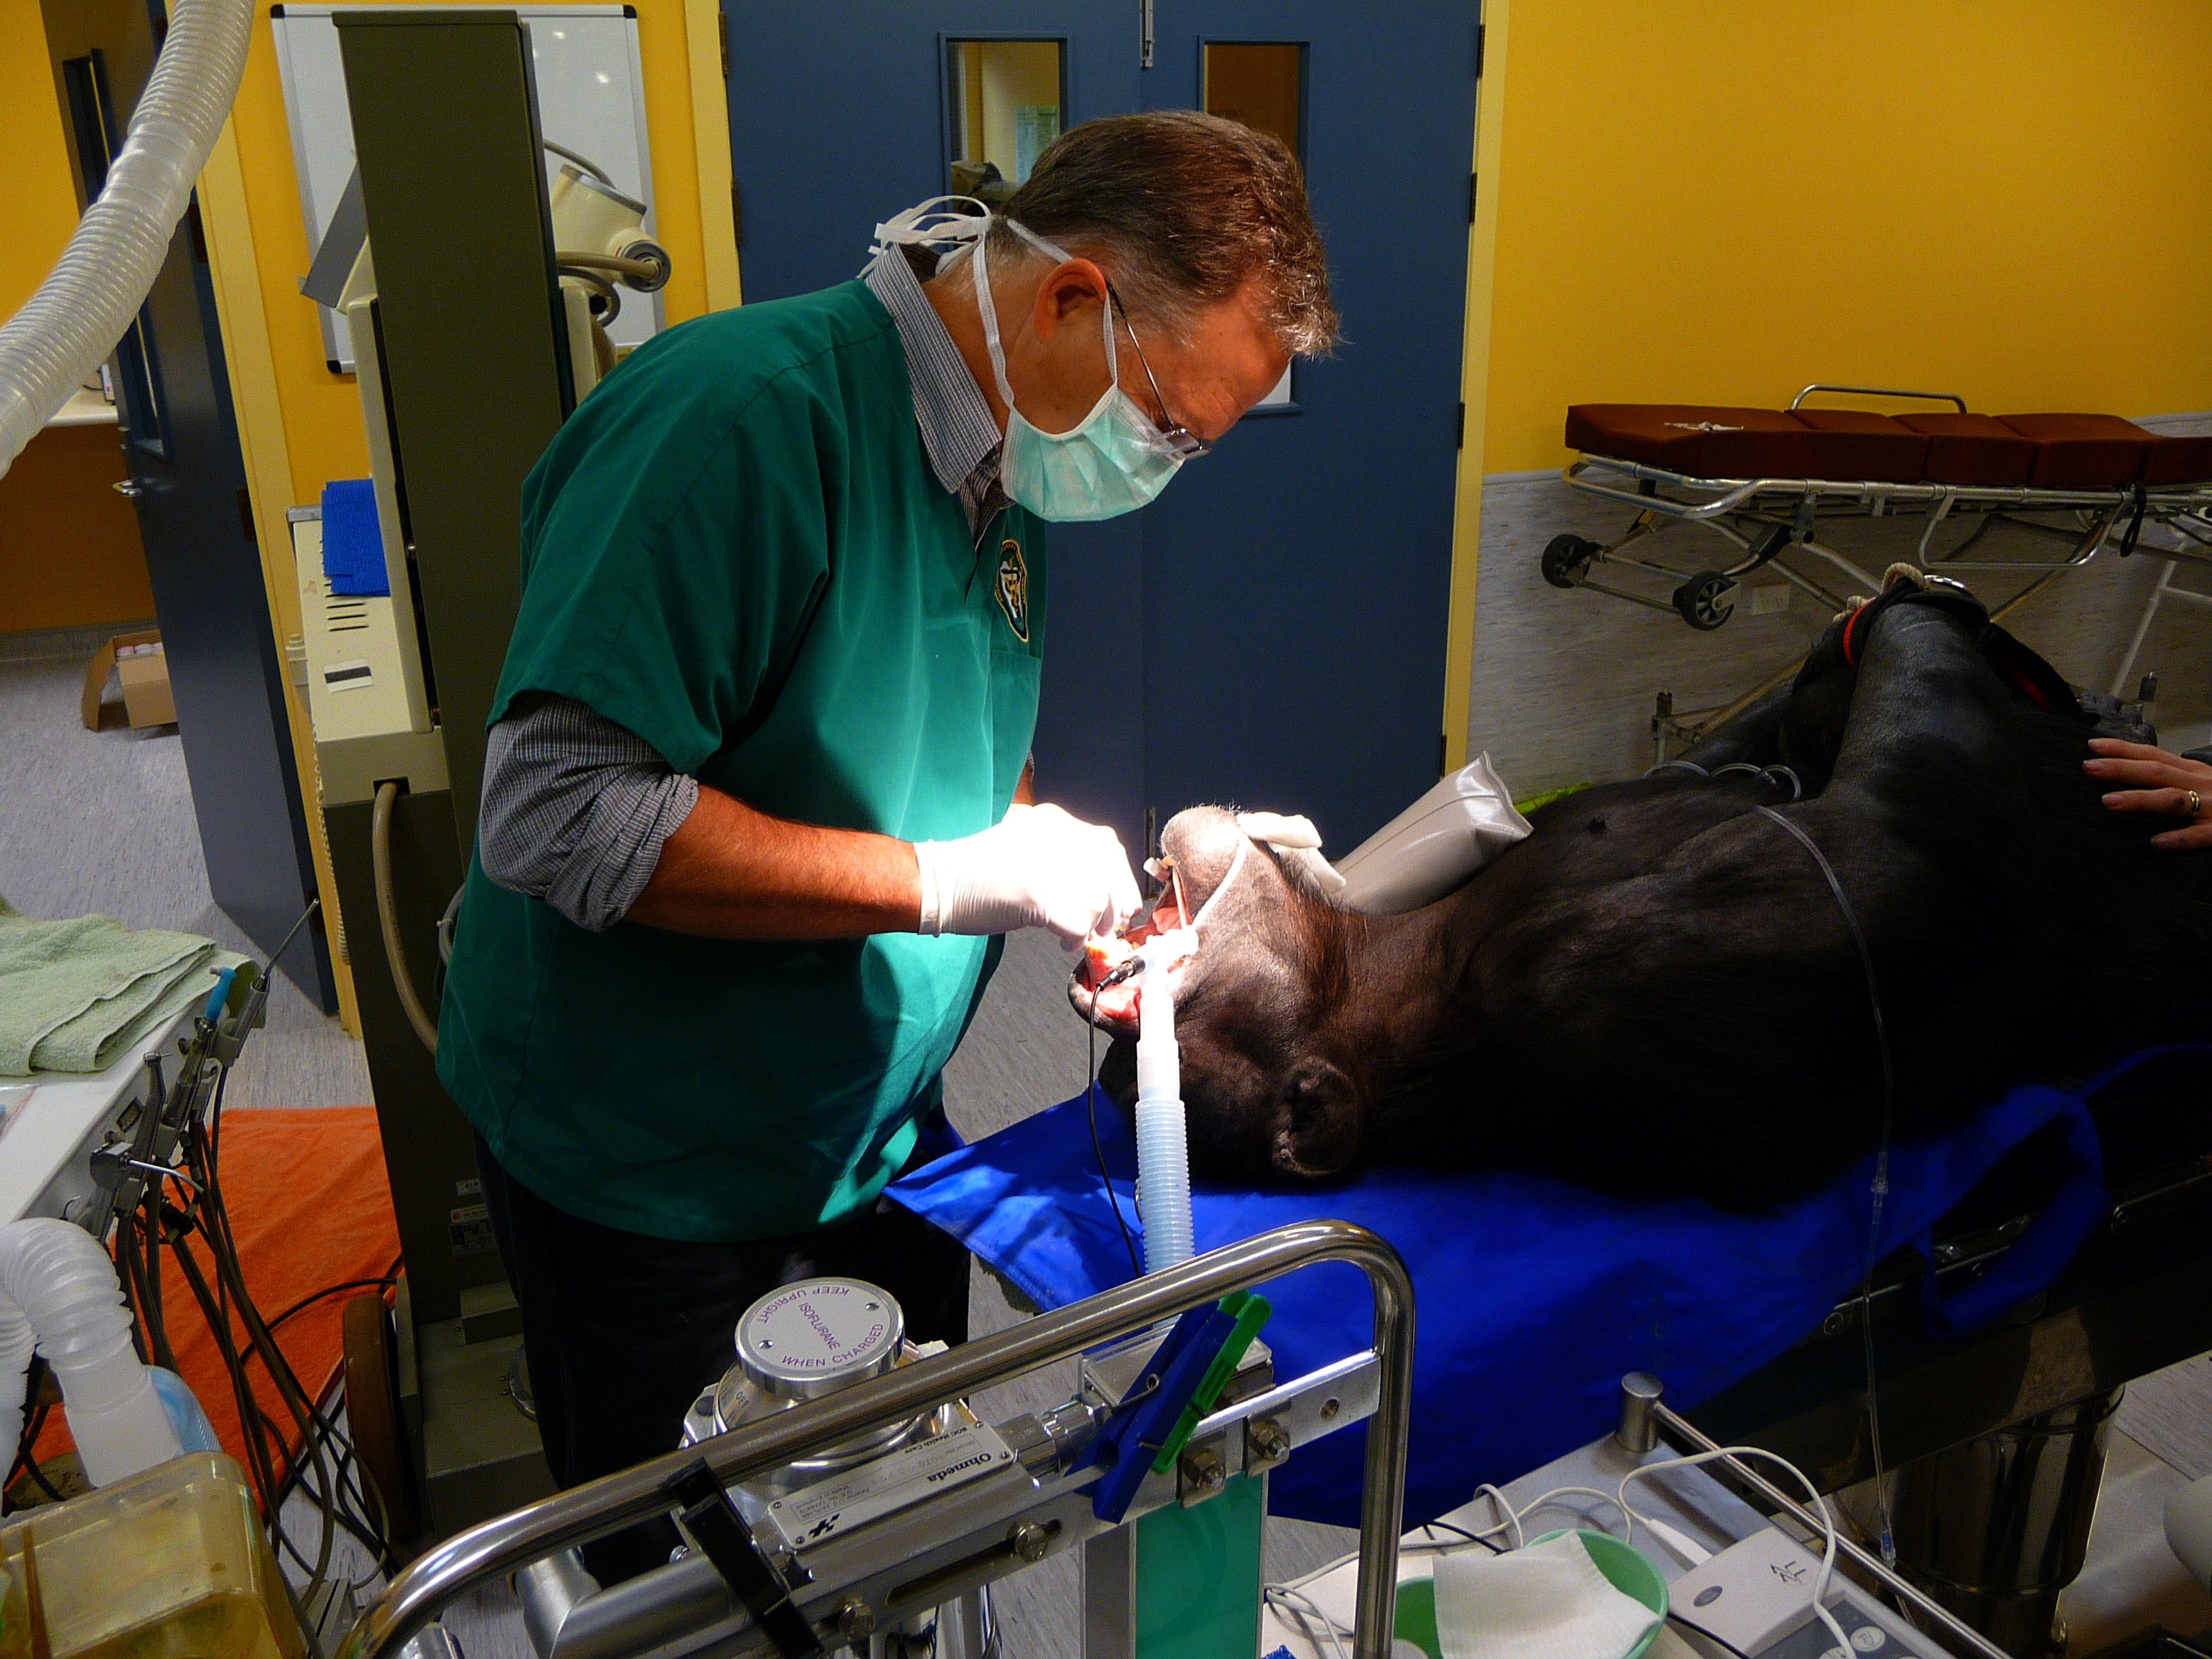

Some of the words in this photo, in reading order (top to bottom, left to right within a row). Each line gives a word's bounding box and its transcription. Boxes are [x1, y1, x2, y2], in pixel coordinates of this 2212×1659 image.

[812, 1286, 849, 1296] KEEP
[757, 1290, 806, 1324] UPRIGHT
[799, 1302, 841, 1350] ISOFLURANE
[782, 1356, 826, 1366] WHEN
[832, 1324, 883, 1363] CHARGED
[736, 1391, 749, 1408] OFF
[924, 1433, 950, 1446] Health
[950, 1426, 967, 1436] BOC
[904, 1444, 923, 1454] Care
[927, 1453, 991, 1482] Ohmeda
